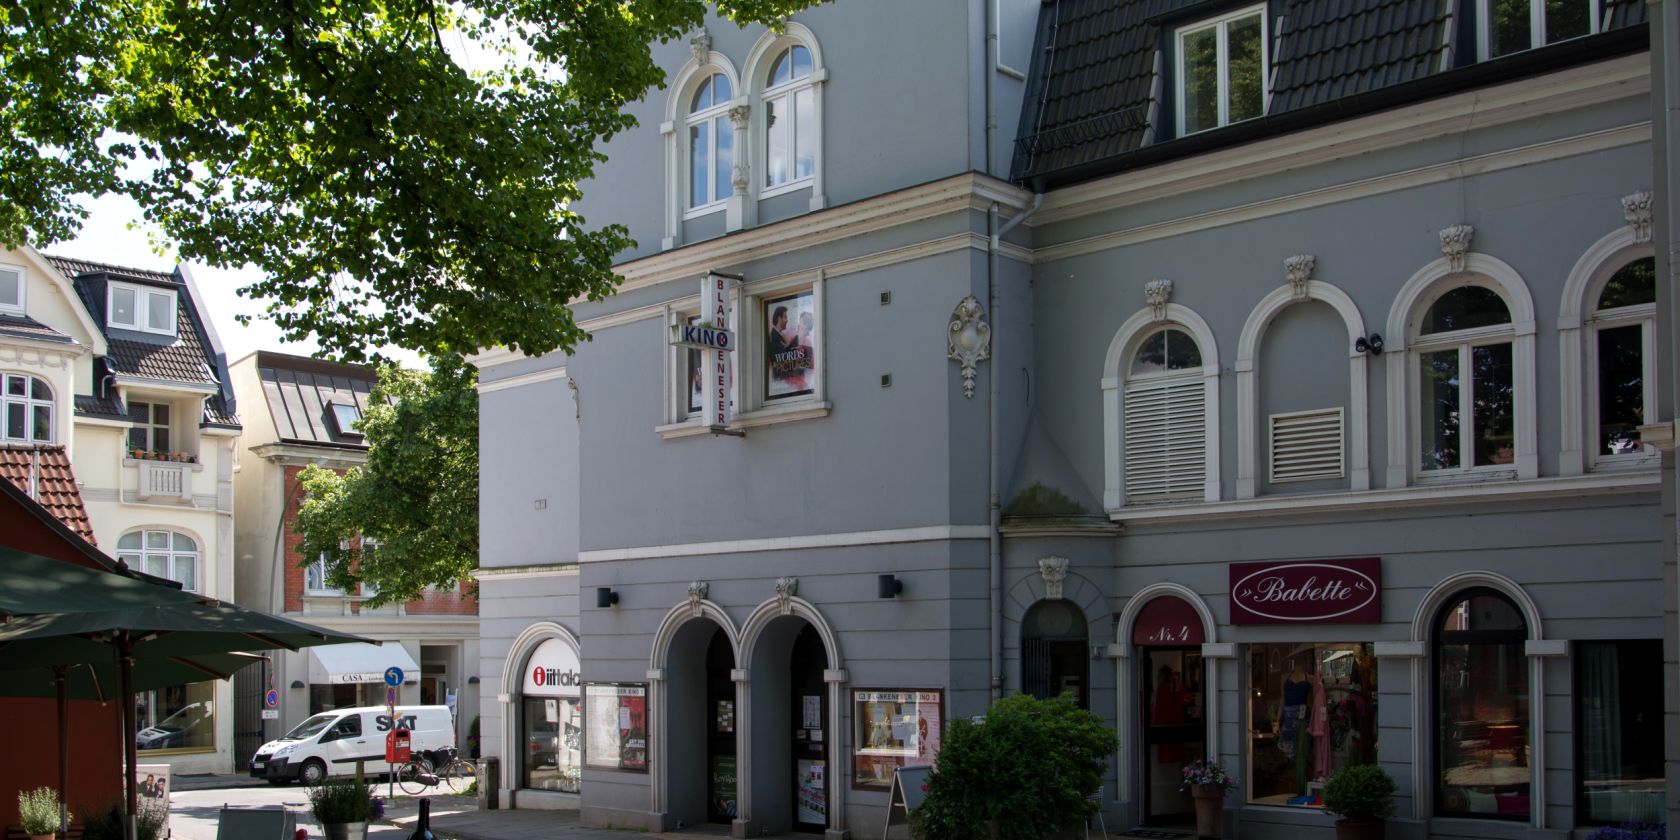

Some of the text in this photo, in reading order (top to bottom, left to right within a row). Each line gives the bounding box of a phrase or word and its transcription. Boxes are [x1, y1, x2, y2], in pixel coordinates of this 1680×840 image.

[685, 325, 729, 347] KINO
[716, 278, 726, 424] BLANKENESER
[775, 348, 805, 363] WORDS
[1149, 625, 1190, 641] Nr. 4
[342, 673, 363, 682] CASA
